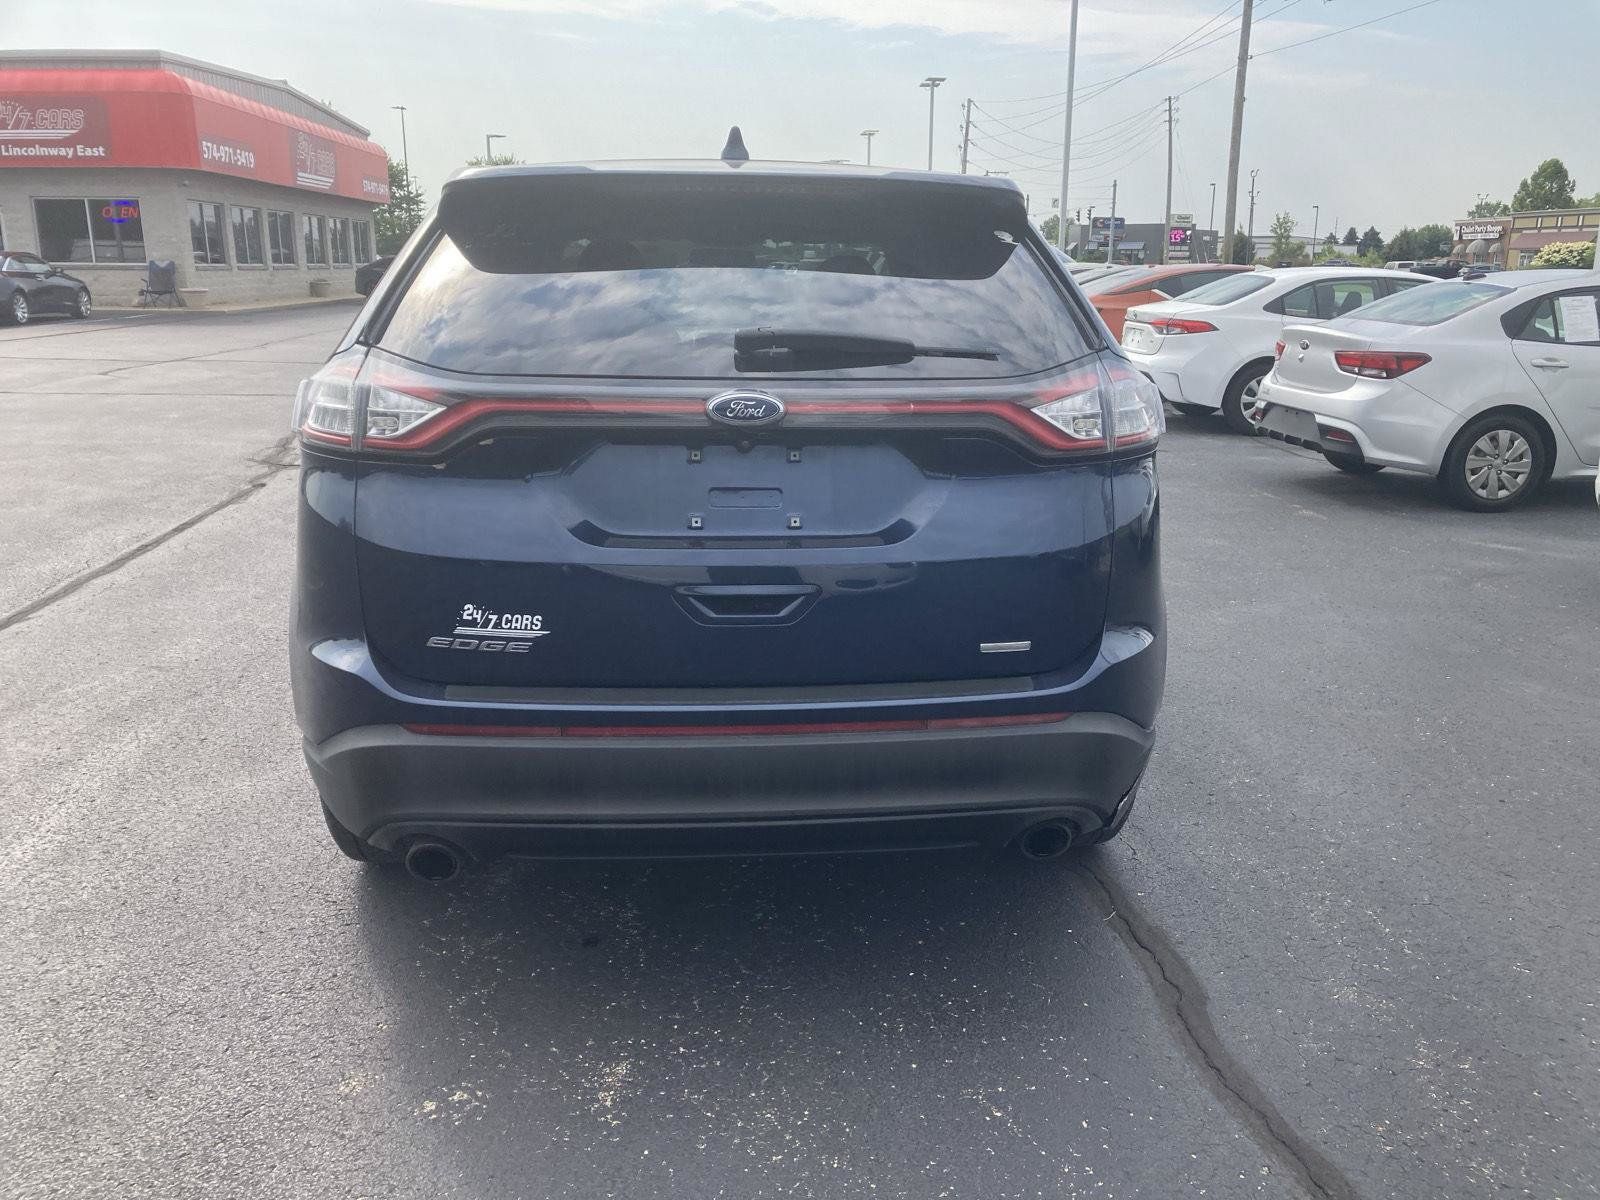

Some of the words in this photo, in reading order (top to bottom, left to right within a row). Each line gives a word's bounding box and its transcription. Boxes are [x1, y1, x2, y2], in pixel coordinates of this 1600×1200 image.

[0, 103, 32, 130] 4/7
[35, 108, 84, 130] CARS
[1, 144, 74, 159] Lincolnway
[76, 145, 105, 157] East
[201, 140, 255, 169] 574-971-5419
[102, 206, 138, 218] OEN
[726, 400, 766, 417] Ford
[462, 603, 499, 630] 24/7
[501, 613, 543, 630] CARS
[426, 636, 533, 653] EDGE
